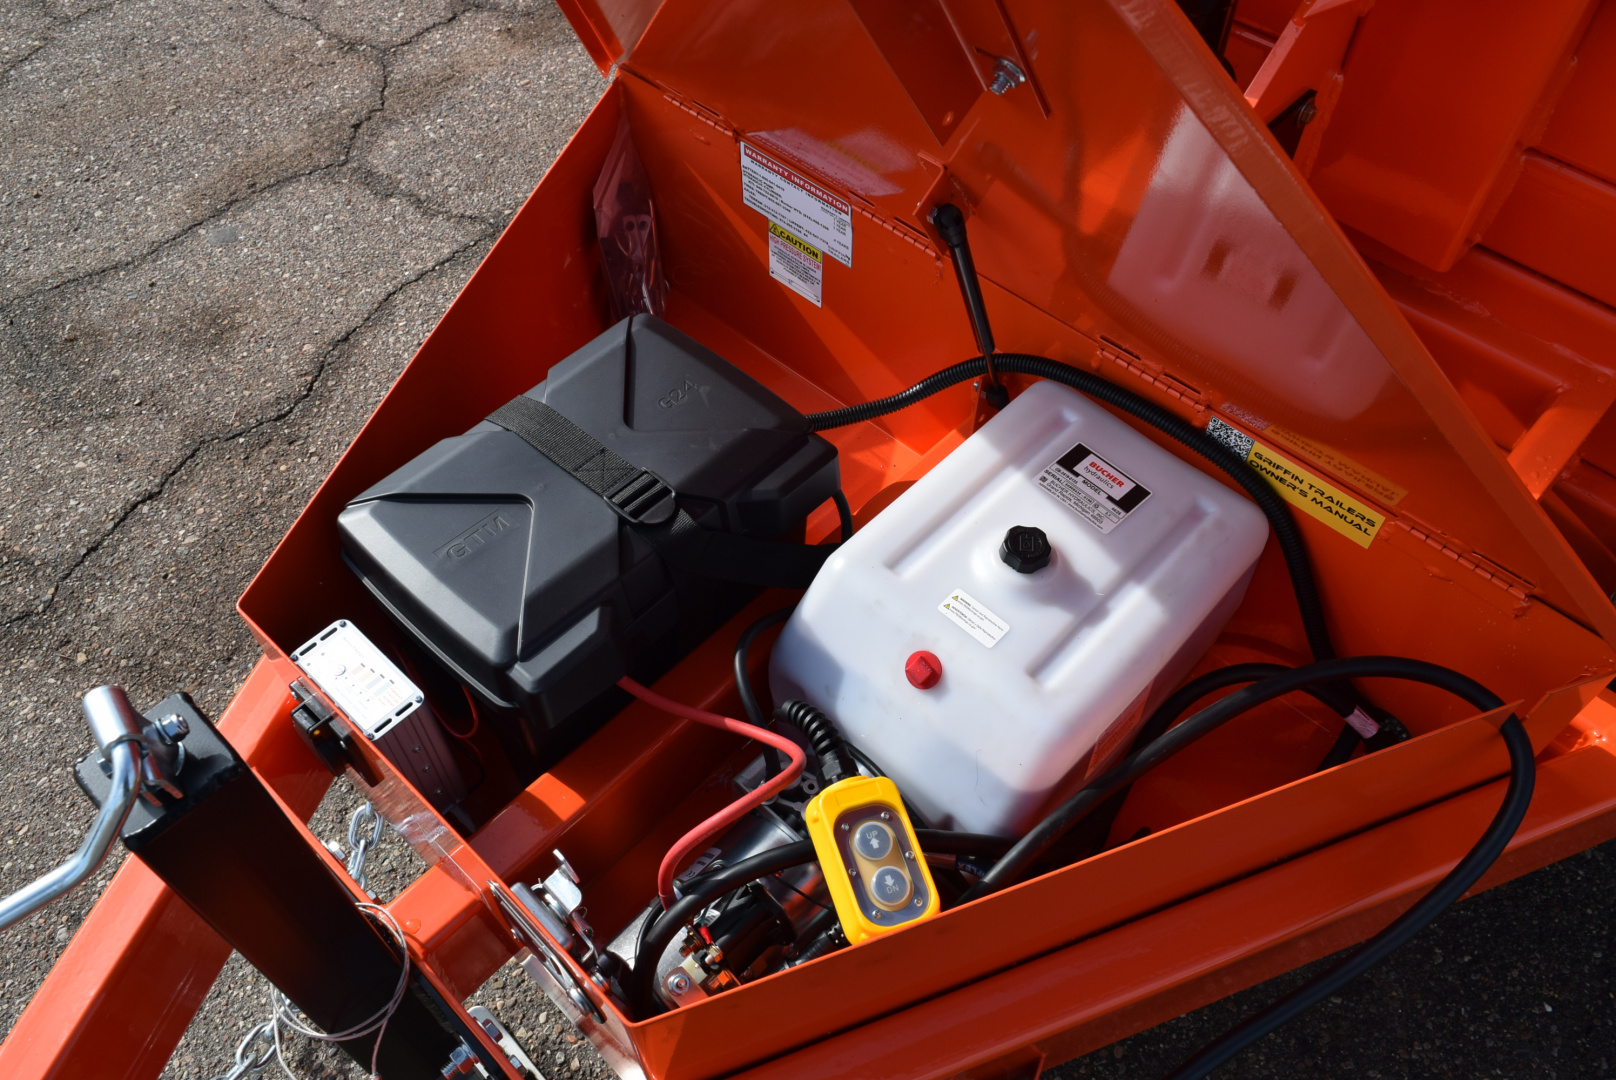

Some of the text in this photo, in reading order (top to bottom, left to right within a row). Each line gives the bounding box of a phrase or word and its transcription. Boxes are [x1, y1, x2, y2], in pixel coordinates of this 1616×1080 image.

[745, 148, 788, 177] WARRANTY
[791, 174, 848, 212] INFORMATION
[751, 160, 778, 178] WARRANTY
[780, 177, 803, 193] CONTACT
[806, 192, 842, 215] INFORMATION
[780, 230, 818, 259] CAUTION
[781, 241, 802, 260] PRESSURE
[657, 379, 699, 411] G24
[1044, 469, 1064, 483] SERIAL
[1050, 480, 1069, 493] BUCHER
[1081, 480, 1103, 495] MODEL
[1082, 466, 1115, 490] hydraulics
[1088, 462, 1125, 487] BUCHER
[1046, 483, 1060, 492] Grand
[1072, 502, 1091, 515] Michigan
[1248, 460, 1373, 536] OWNER'S MANUAL
[1253, 452, 1377, 527] GRIFFIN TRAILERS
[446, 513, 511, 560] GTM
[865, 830, 878, 840] UP
[886, 885, 900, 894] DN
